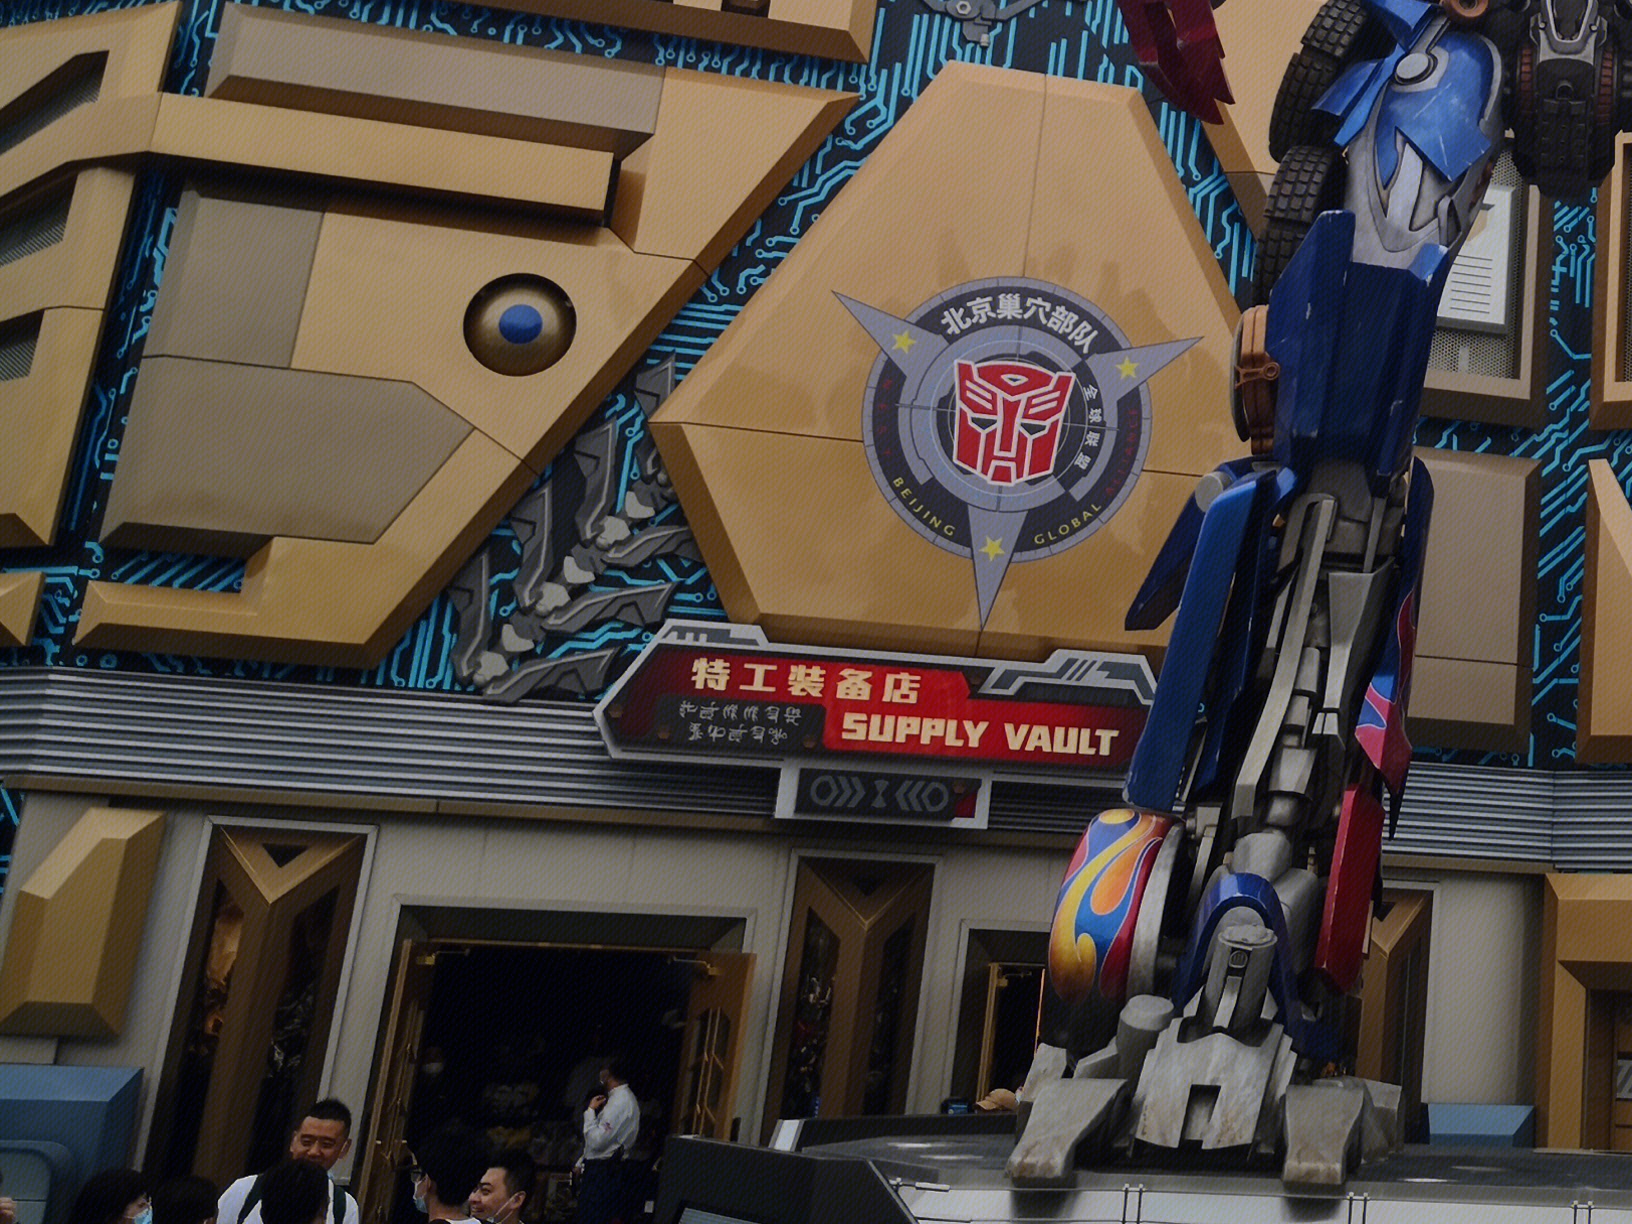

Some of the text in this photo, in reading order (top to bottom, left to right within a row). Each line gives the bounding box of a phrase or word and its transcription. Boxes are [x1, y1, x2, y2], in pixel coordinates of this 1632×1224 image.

[941, 292, 1099, 354] 北京巢穴部队
[1073, 383, 1104, 471] 全球联盟
[892, 476, 956, 537] BEIJING
[1033, 503, 1103, 546] GLOBAL
[691, 657, 922, 705] 特工装备店
[841, 712, 989, 749] SUPPLY
[1003, 722, 1120, 757] VAULT
